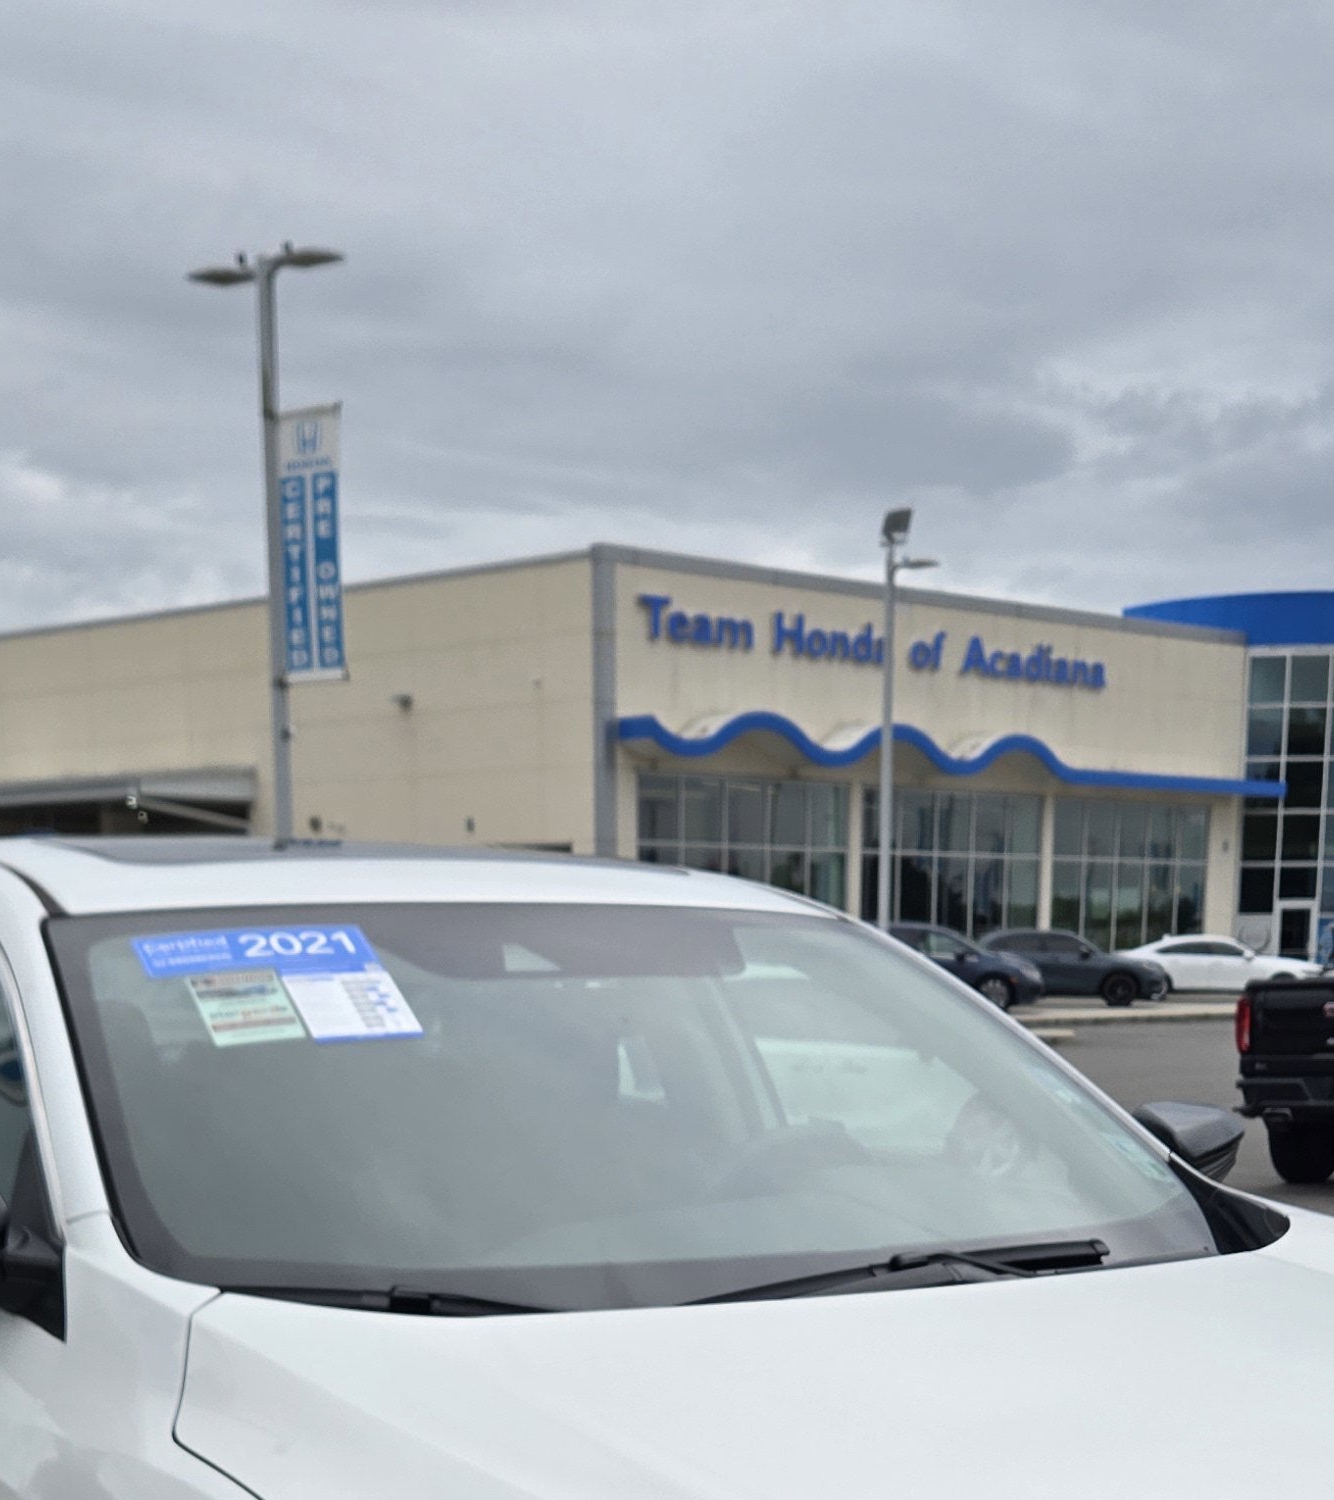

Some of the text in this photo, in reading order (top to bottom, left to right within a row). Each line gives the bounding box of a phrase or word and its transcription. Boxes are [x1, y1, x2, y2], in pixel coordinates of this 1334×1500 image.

[637, 594, 755, 651] Team
[909, 631, 946, 671] of
[961, 636, 1105, 690] Acadiana
[238, 931, 357, 958] 2021
